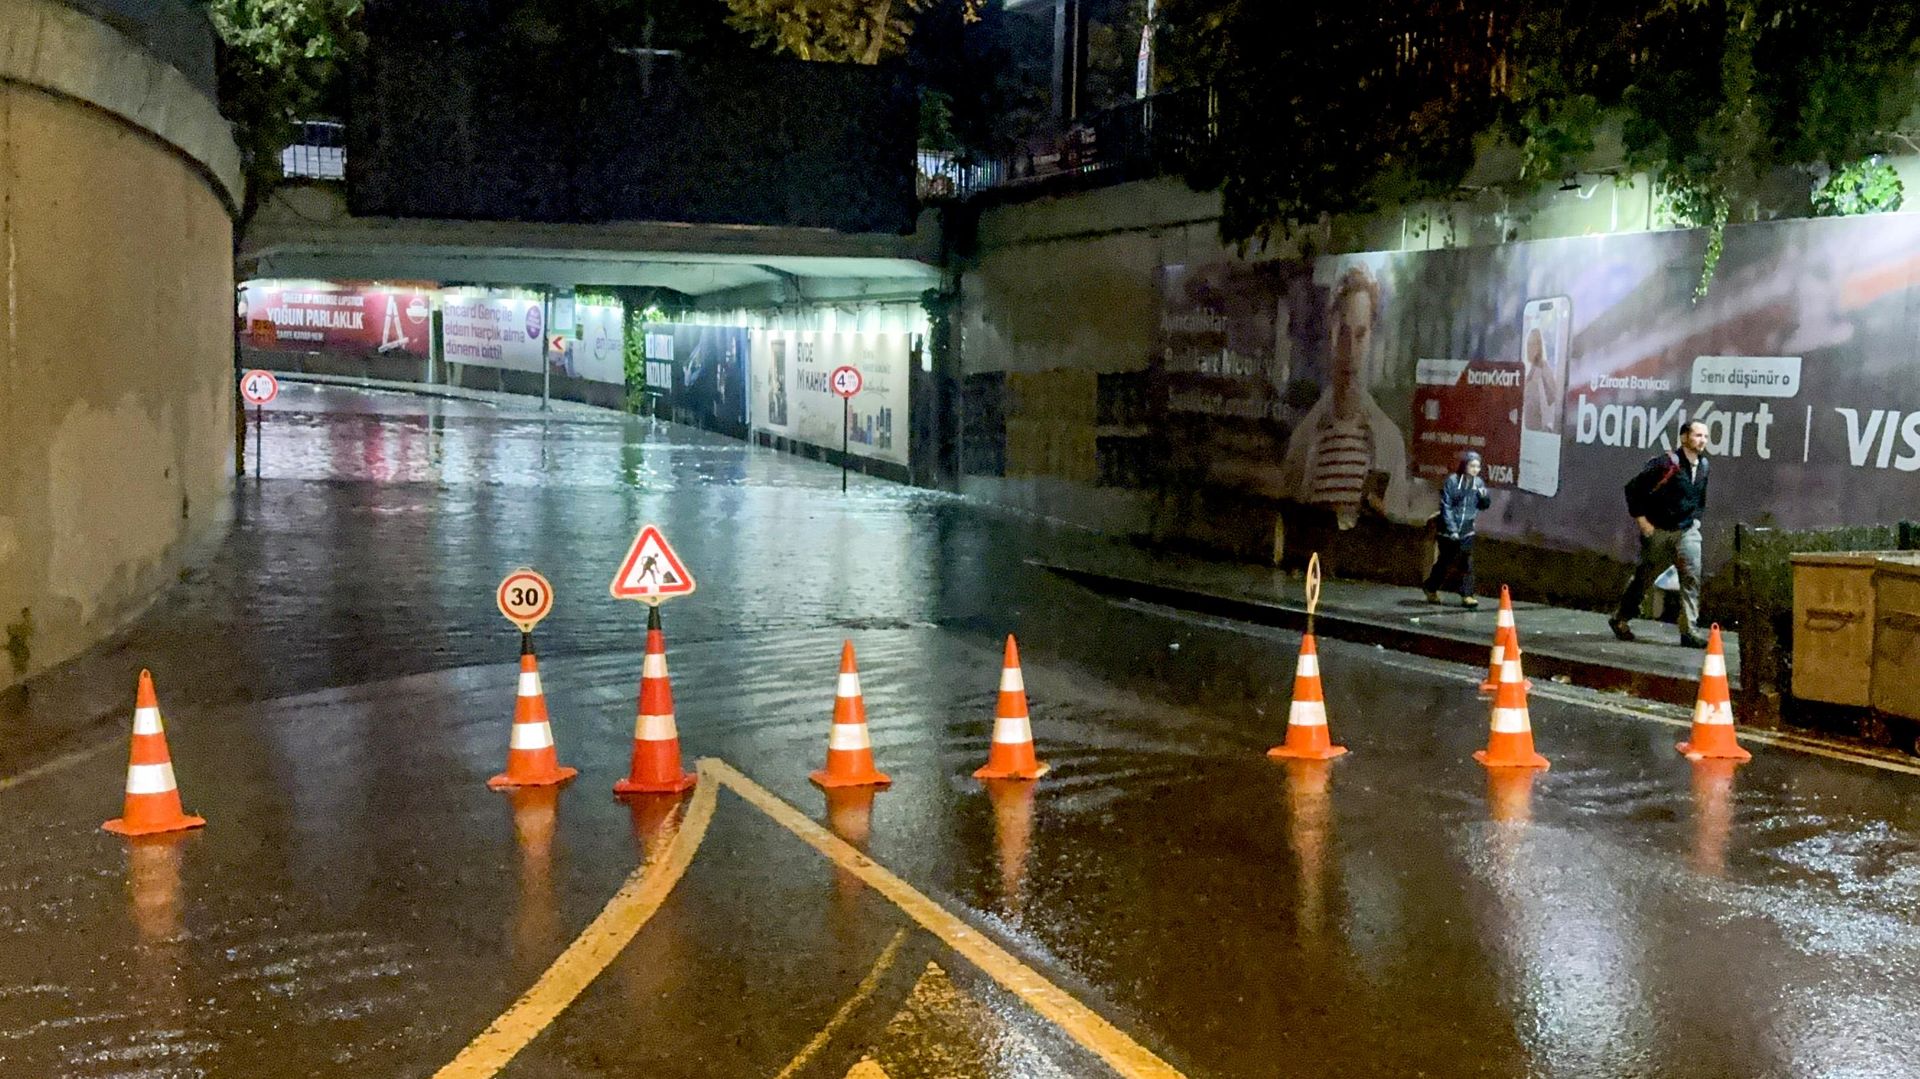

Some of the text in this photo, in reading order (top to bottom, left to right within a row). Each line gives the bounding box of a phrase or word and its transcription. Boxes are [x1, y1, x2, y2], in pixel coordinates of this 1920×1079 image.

[267, 304, 364, 329] YOĞUN PARLAKLIK
[478, 304, 501, 322] Genç
[502, 308, 513, 322] ile
[445, 321, 525, 343] elden harçlık alma
[445, 341, 502, 360] dönemi bitti!
[248, 379, 258, 394] 4
[805, 370, 828, 393] KAHVE
[837, 374, 846, 388] 4
[1599, 375, 1670, 391] Ziraat Bankası
[1701, 366, 1790, 389] Seni düşünür o
[1487, 464, 1514, 484] VISA
[511, 588, 538, 606] 30
